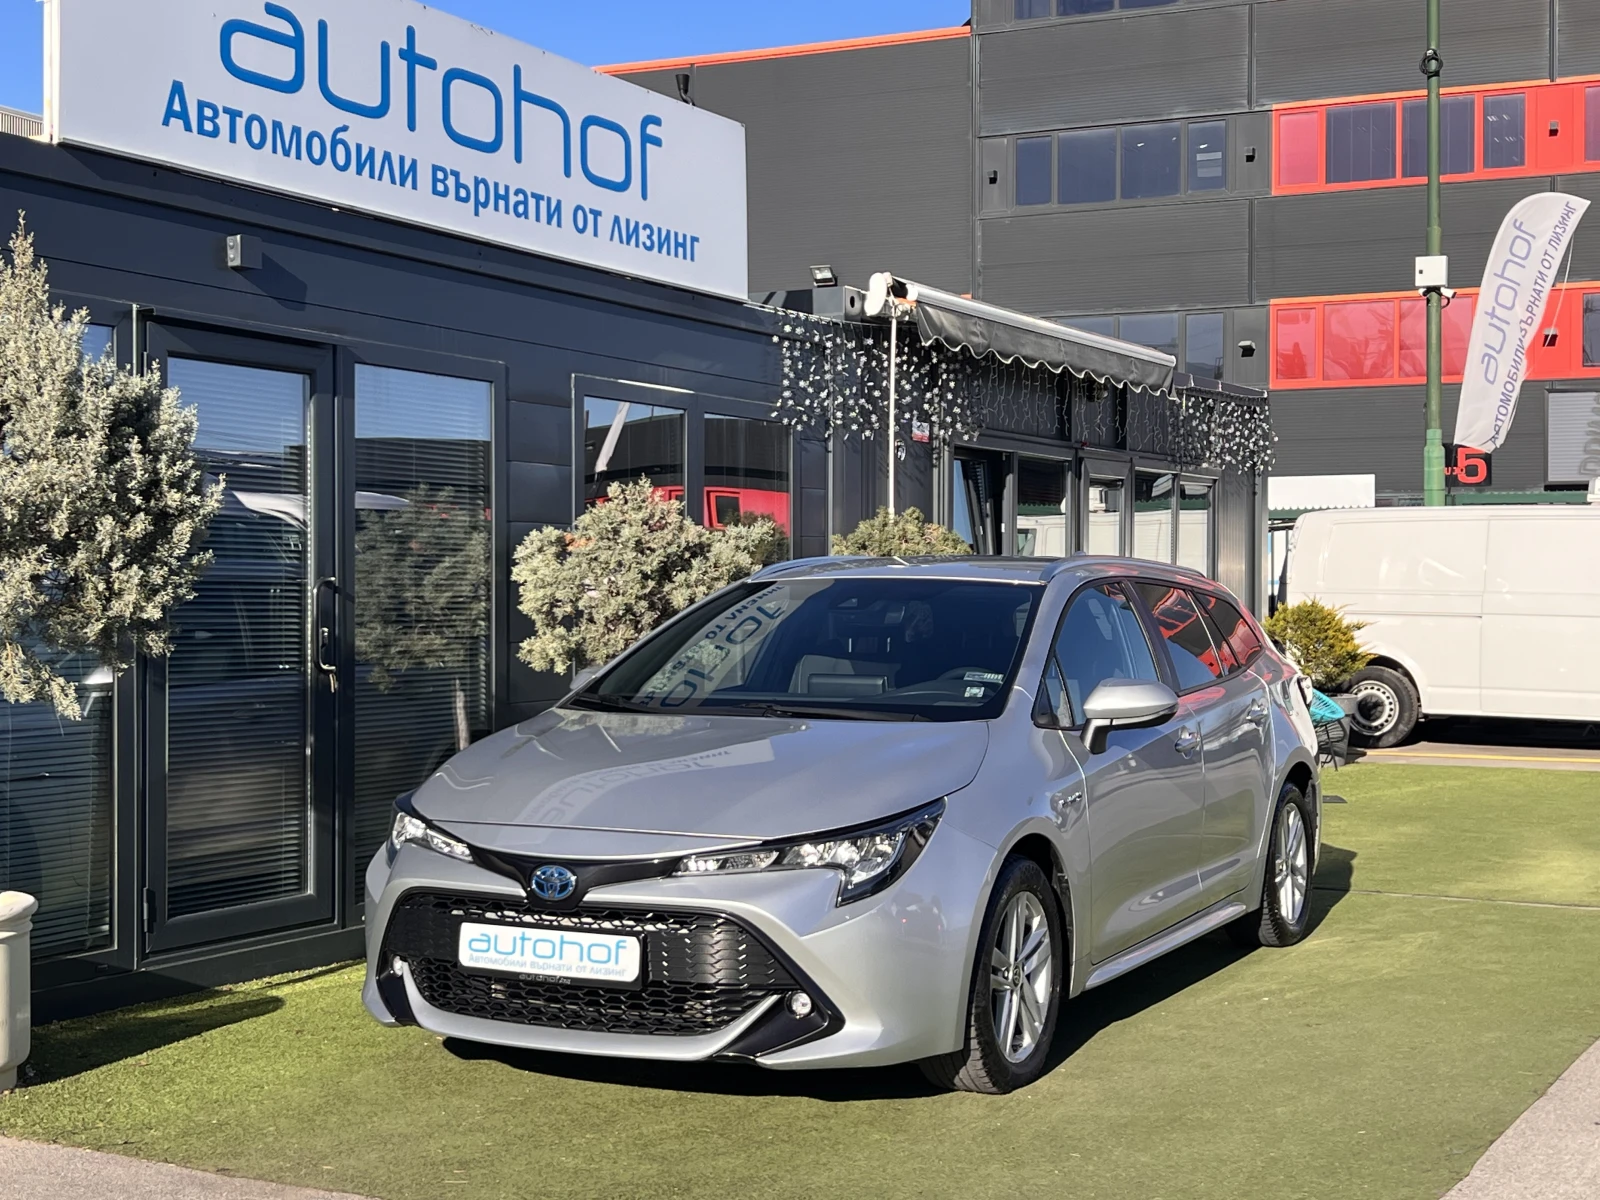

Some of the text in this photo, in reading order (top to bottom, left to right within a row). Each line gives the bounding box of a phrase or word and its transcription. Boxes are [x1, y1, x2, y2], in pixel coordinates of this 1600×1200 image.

[220, 1, 663, 201] autohof
[161, 79, 700, 262] Автомобили върнати от лизинг
[1540, 248, 1555, 271] ОТ
[1548, 200, 1577, 251] ЛИЗИНГ
[1480, 217, 1537, 386] autohof
[1457, 447, 1487, 484] 5
[468, 931, 627, 966] autohof
[468, 953, 627, 978] Автомобили върнати от лизинг
